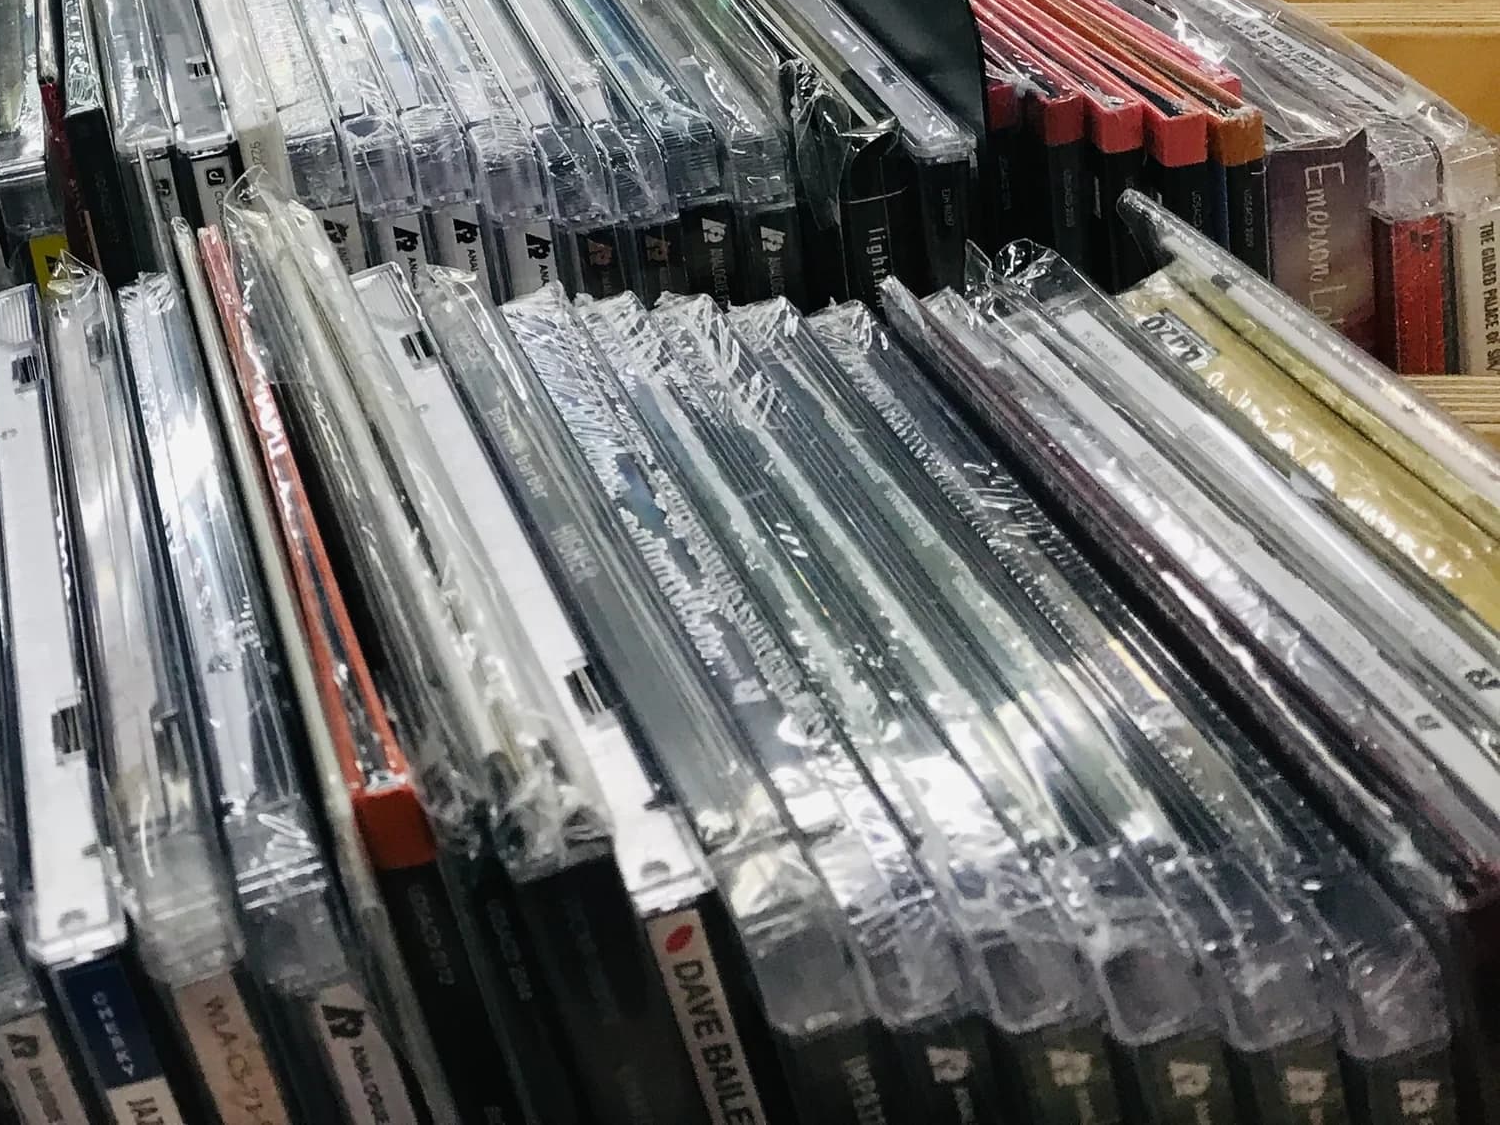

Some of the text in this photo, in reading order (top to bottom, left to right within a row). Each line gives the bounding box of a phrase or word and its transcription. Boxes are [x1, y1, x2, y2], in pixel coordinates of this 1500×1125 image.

[1303, 160, 1346, 284] Emerson
[1479, 220, 1496, 246] THE
[1480, 246, 1497, 286] GILDED
[1482, 285, 1499, 331] PALACE
[1484, 331, 1497, 346] OF
[514, 453, 550, 500] barber
[673, 958, 756, 1125] DAVE BAILE
